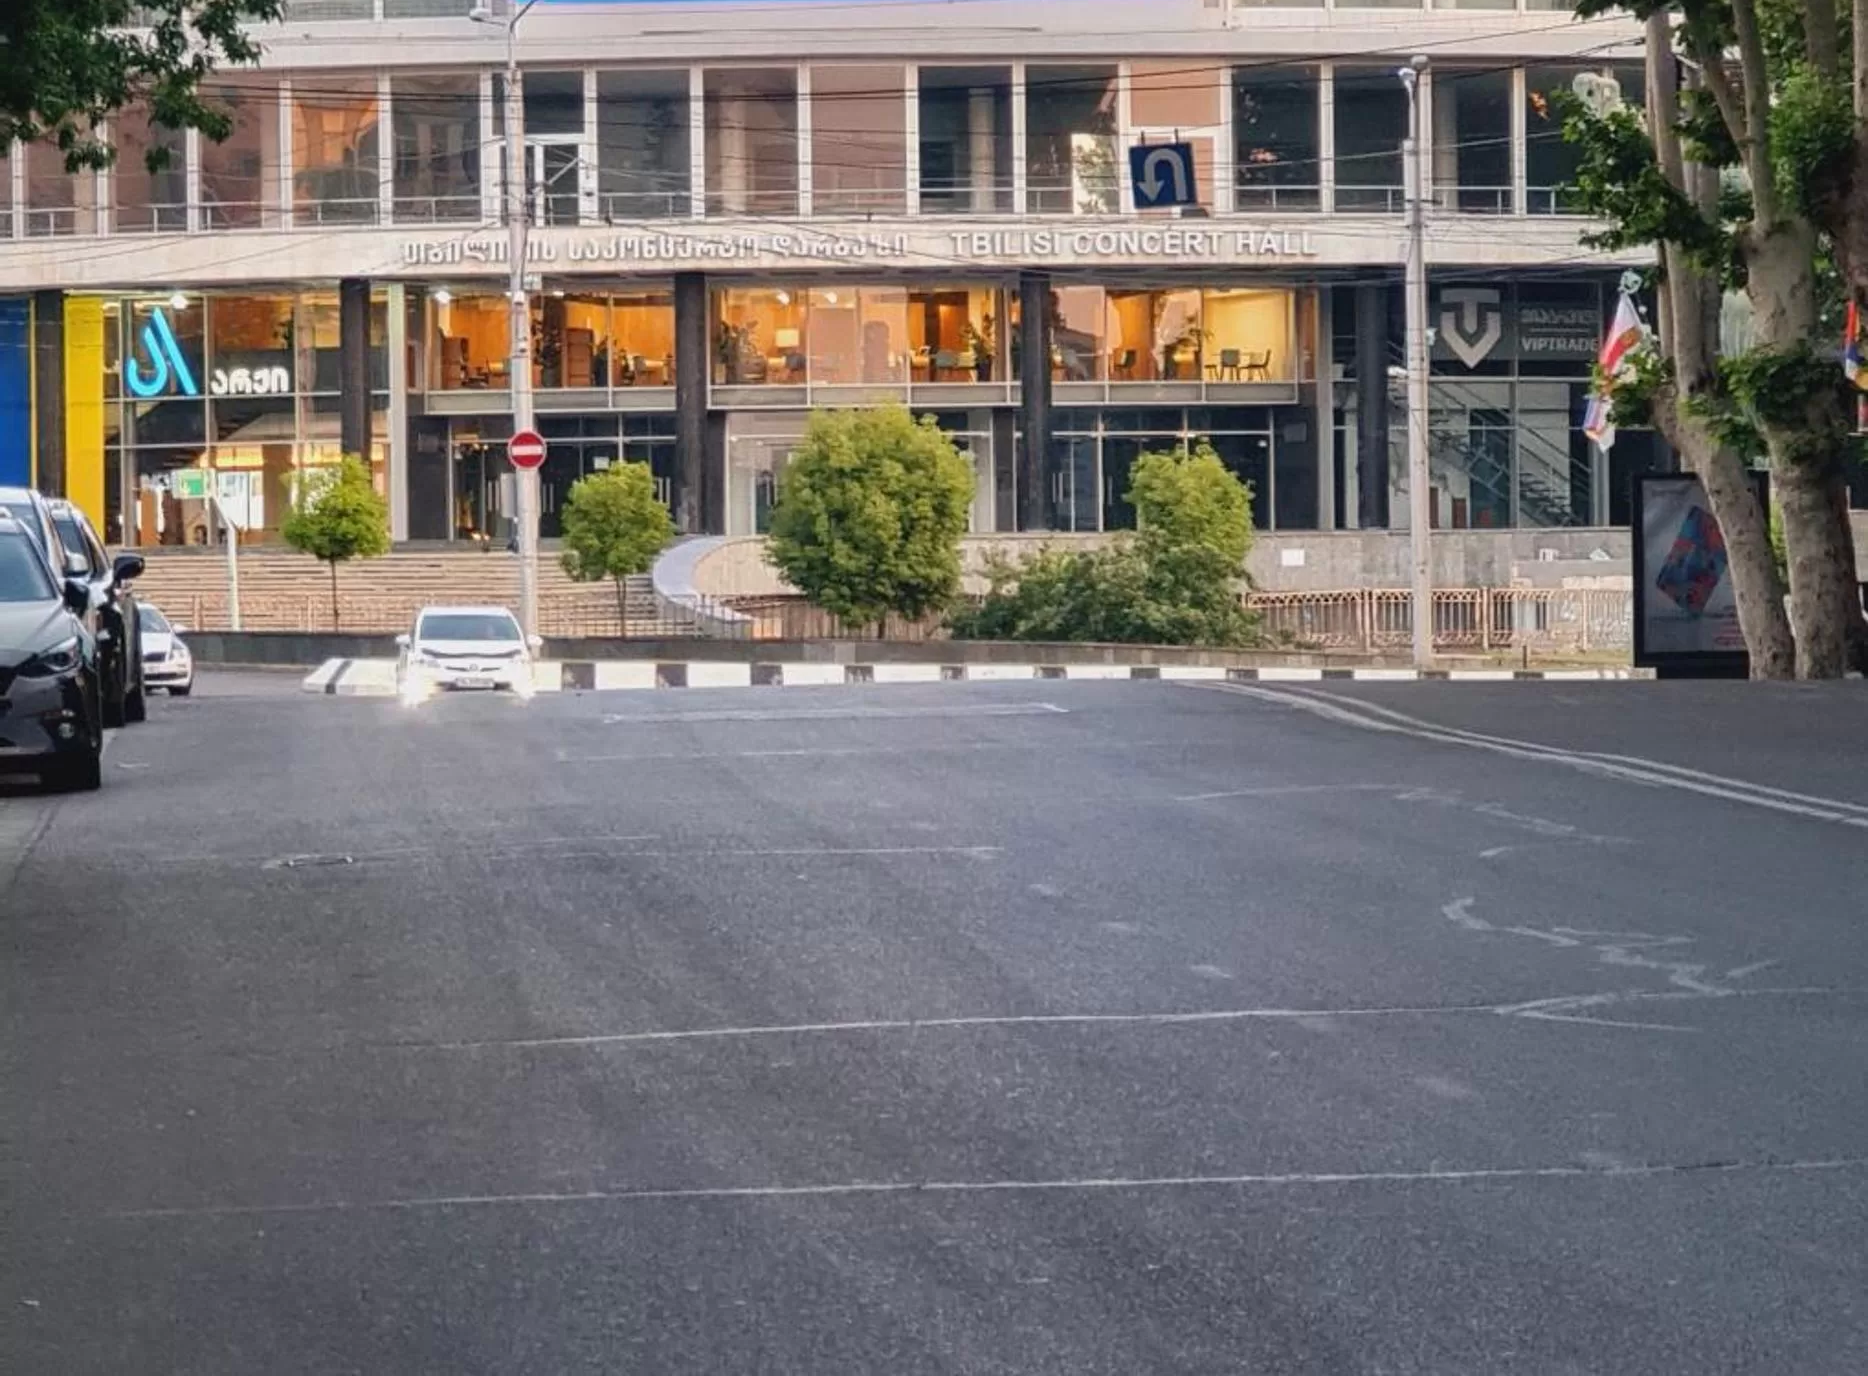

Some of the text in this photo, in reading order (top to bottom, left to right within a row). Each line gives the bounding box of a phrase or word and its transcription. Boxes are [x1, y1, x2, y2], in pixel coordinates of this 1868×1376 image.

[403, 237, 556, 264] თბილიის
[949, 229, 1319, 256] TBILISI CONCERT HALL
[1521, 336, 1598, 352] VIPTRADE
